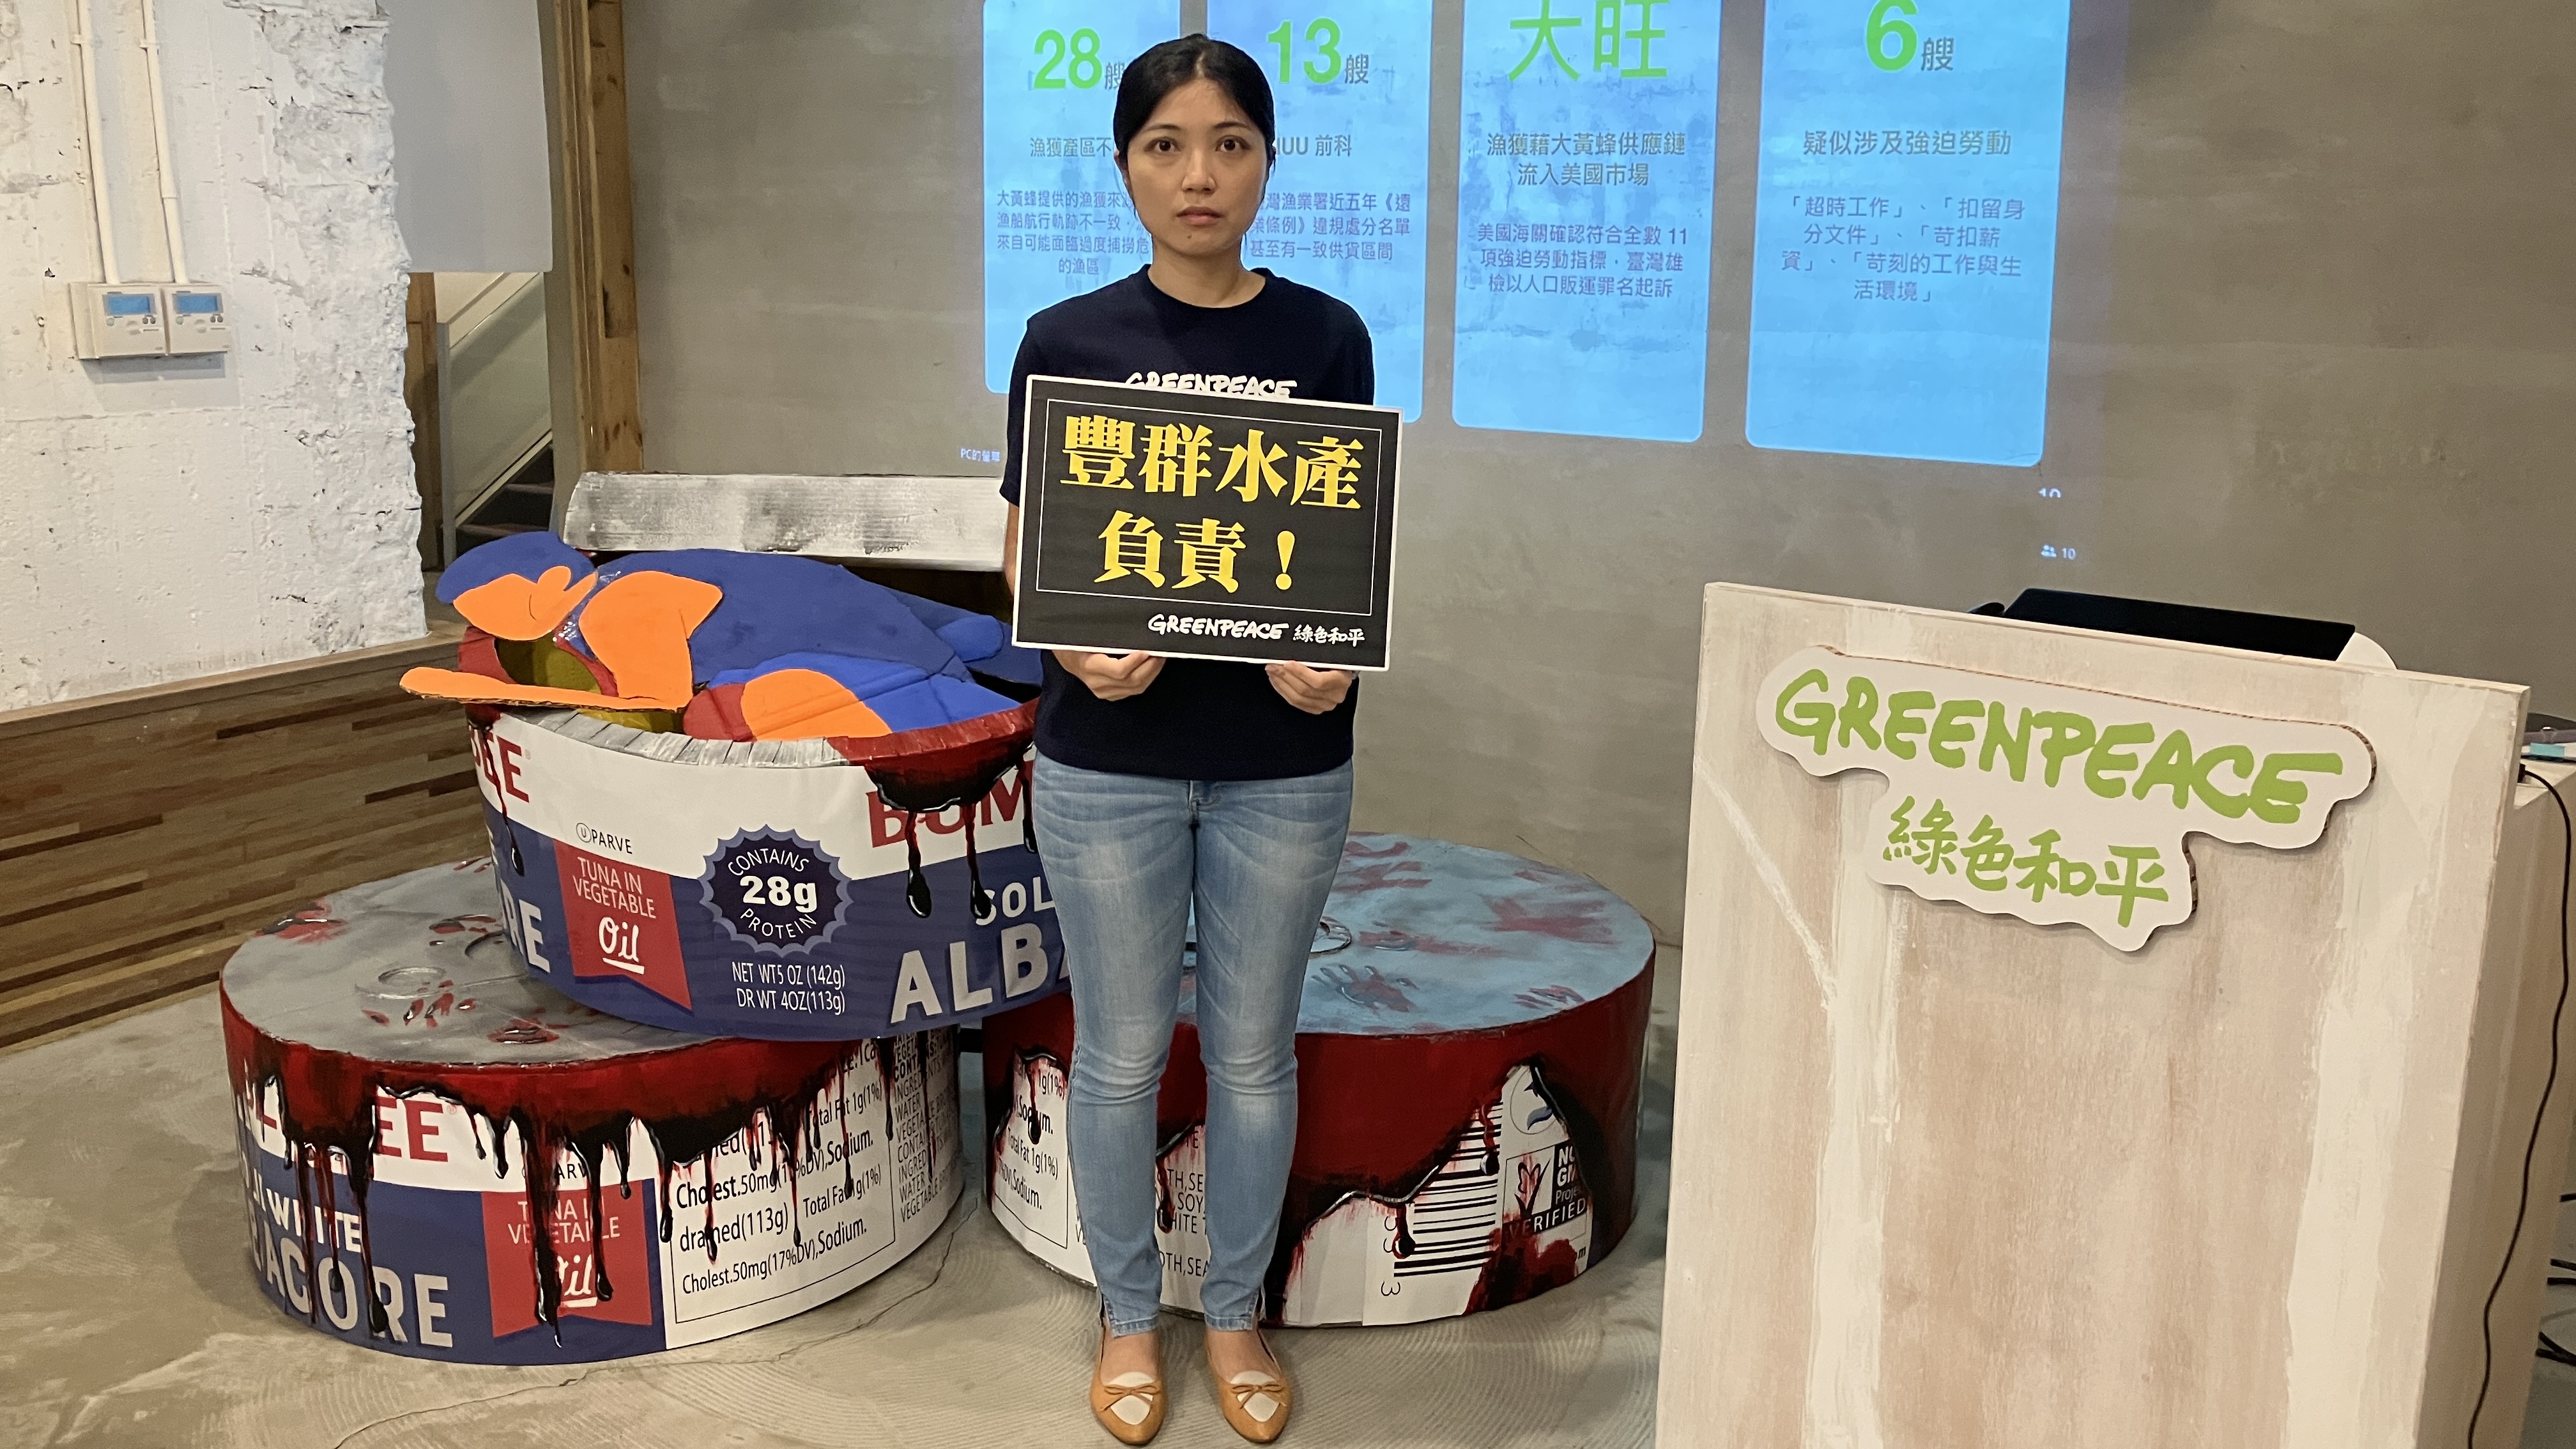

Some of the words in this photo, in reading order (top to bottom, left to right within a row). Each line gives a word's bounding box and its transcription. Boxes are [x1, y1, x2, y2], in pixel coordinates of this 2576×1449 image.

[1508, 0, 1671, 81] 大旺
[1030, 137, 1112, 158] 漁獲產區不
[1315, 134, 1353, 157] 前科
[1487, 132, 1685, 157] 漁獲藉大黃蜂供應鏈
[1803, 130, 2012, 156] 疑似涉及強迫勞動
[1517, 162, 1649, 186] 流入美國市場
[1259, 192, 1411, 212] 灣漁業署近五年《遠
[1476, 224, 1662, 245] 美國海關確認符合全數
[1668, 227, 1687, 245] 11
[1250, 240, 1393, 261] 甚至有一致供貨區間
[1058, 257, 1100, 275] 的漁區
[1488, 274, 1673, 298] 檢以人口販運罪名起訴
[1060, 415, 1364, 510] 豐群水產
[1094, 510, 1298, 594] 負責！
[1147, 613, 1289, 640] GREENPEACE
[1292, 624, 1365, 647] 綠色和平
[1775, 668, 2343, 825] GREENPEACE
[591, 829, 632, 855] PARVE
[577, 856, 622, 889] TUNA
[624, 871, 643, 895] IN
[728, 848, 809, 876] CONTAINS
[1882, 795, 2170, 928] 綠色和平
[572, 875, 656, 919] VEGETABLE
[740, 875, 818, 914] 28g
[740, 908, 817, 939] PROTEIN
[599, 916, 640, 963] Oil
[732, 962, 754, 983] NET
[787, 965, 804, 985] OZ
[807, 964, 845, 991] (142g)
[891, 923, 1071, 1023] ALB
[736, 988, 755, 1008] DR
[756, 990, 777, 1009] WT
[895, 1091, 921, 1123] WATER
[899, 1170, 926, 1204] WATER
[803, 1188, 830, 1218] Total
